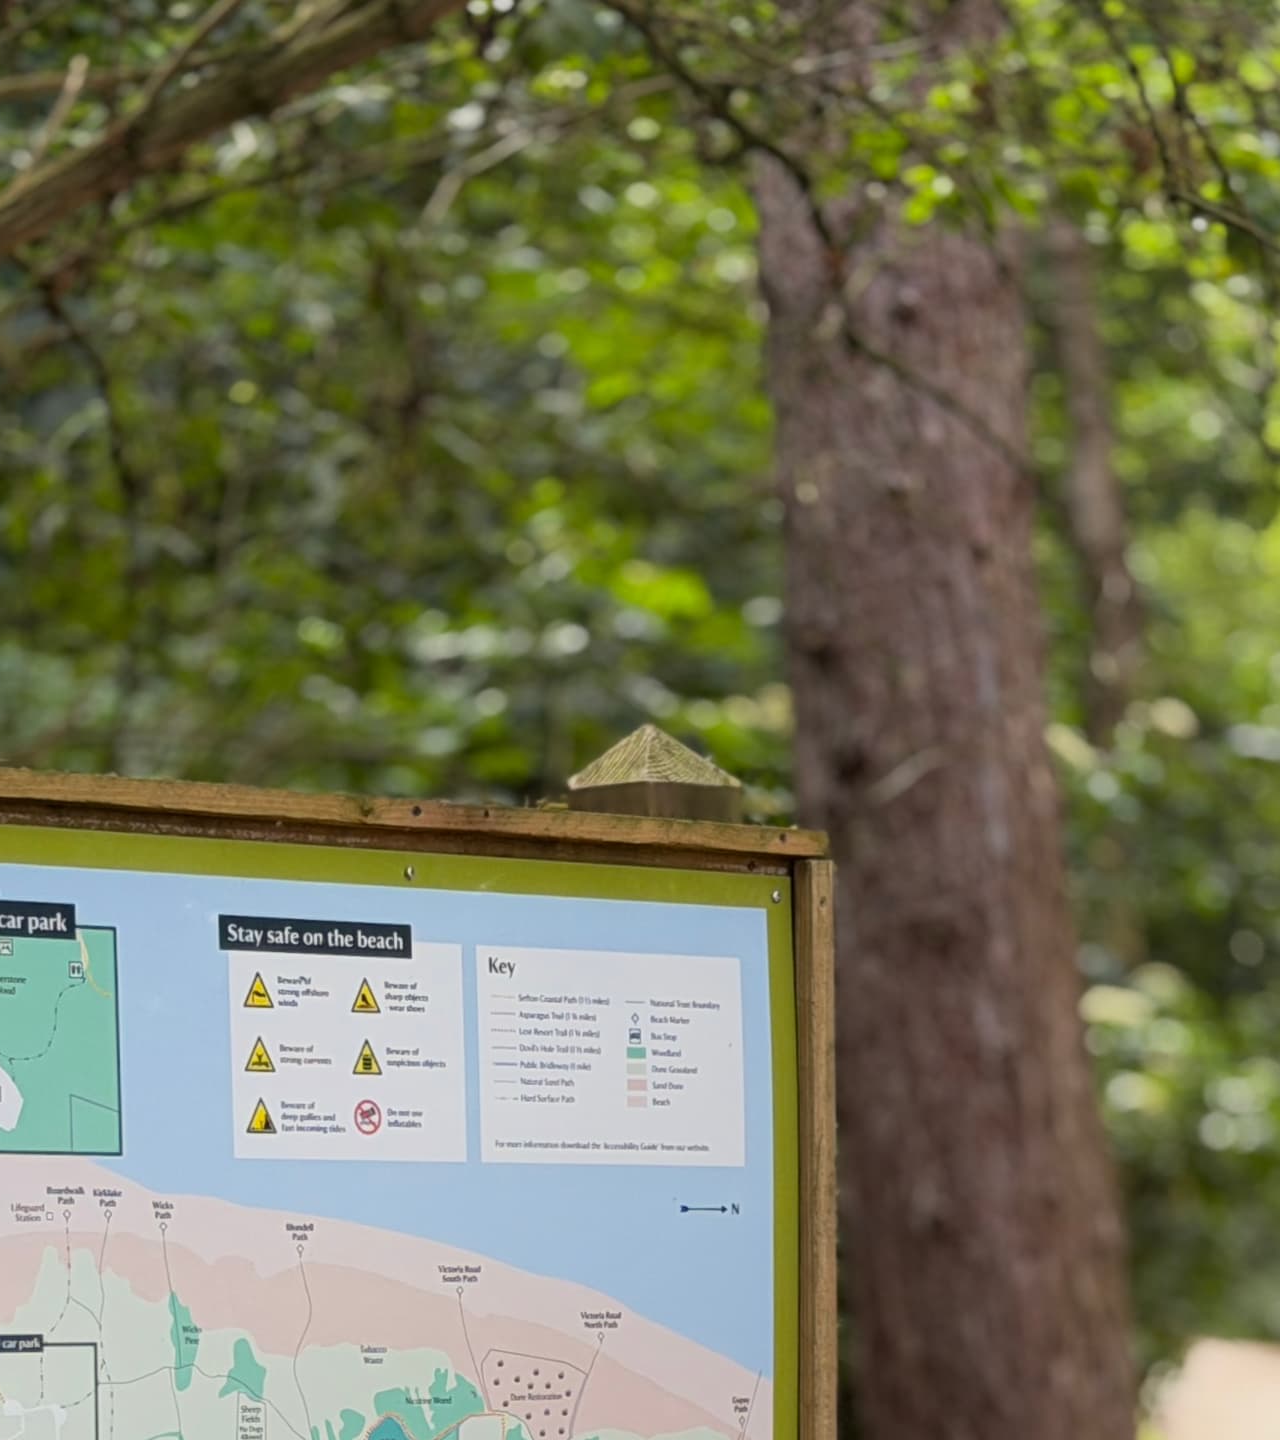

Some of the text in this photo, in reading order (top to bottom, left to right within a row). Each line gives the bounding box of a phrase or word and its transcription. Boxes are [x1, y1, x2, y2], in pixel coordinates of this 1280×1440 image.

[27, 912, 67, 934] park
[227, 923, 404, 950] Stay safe on the beach
[488, 957, 516, 978] Key
[731, 1203, 740, 1215] N
[2, 1339, 17, 1349] car
[18, 1337, 40, 1350] park
